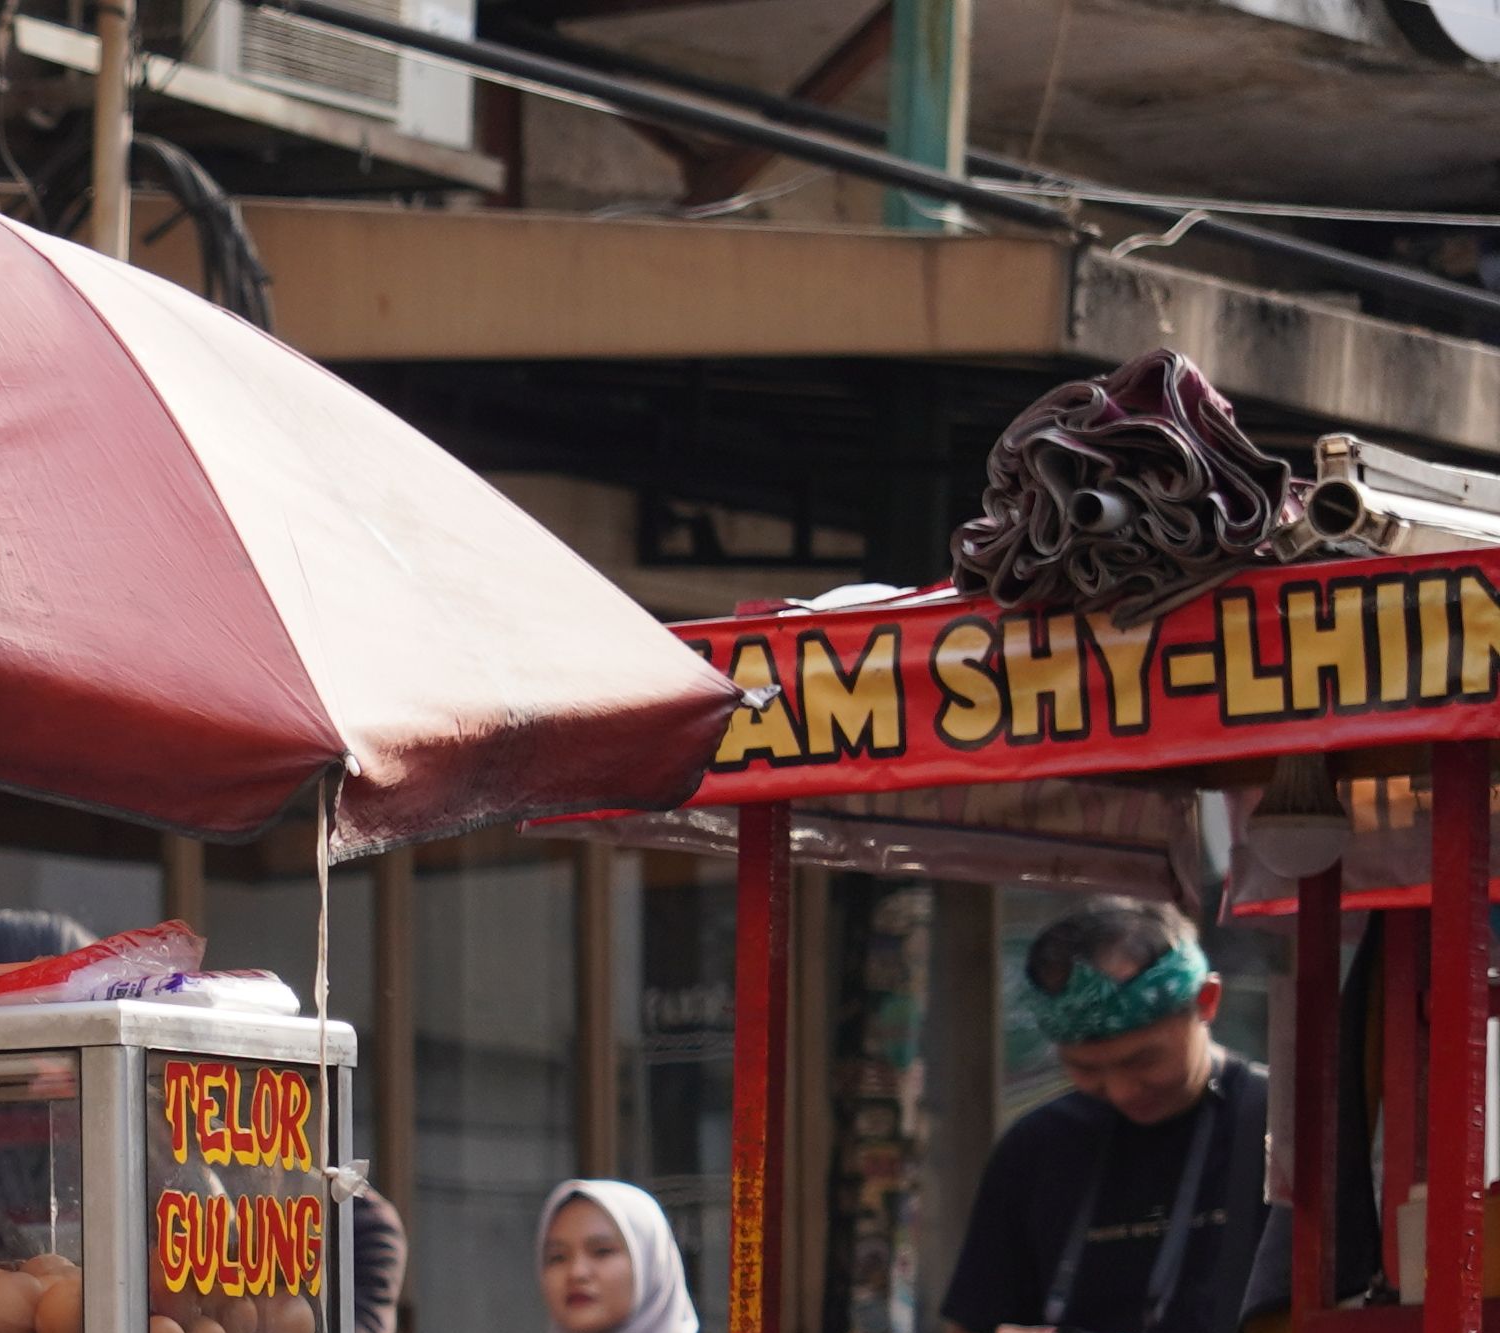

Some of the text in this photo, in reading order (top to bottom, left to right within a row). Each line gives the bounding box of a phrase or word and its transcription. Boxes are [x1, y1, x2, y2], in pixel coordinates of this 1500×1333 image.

[680, 622, 908, 774] AM
[164, 1060, 312, 1173] TELOR
[156, 1190, 322, 1297] GULUNG
